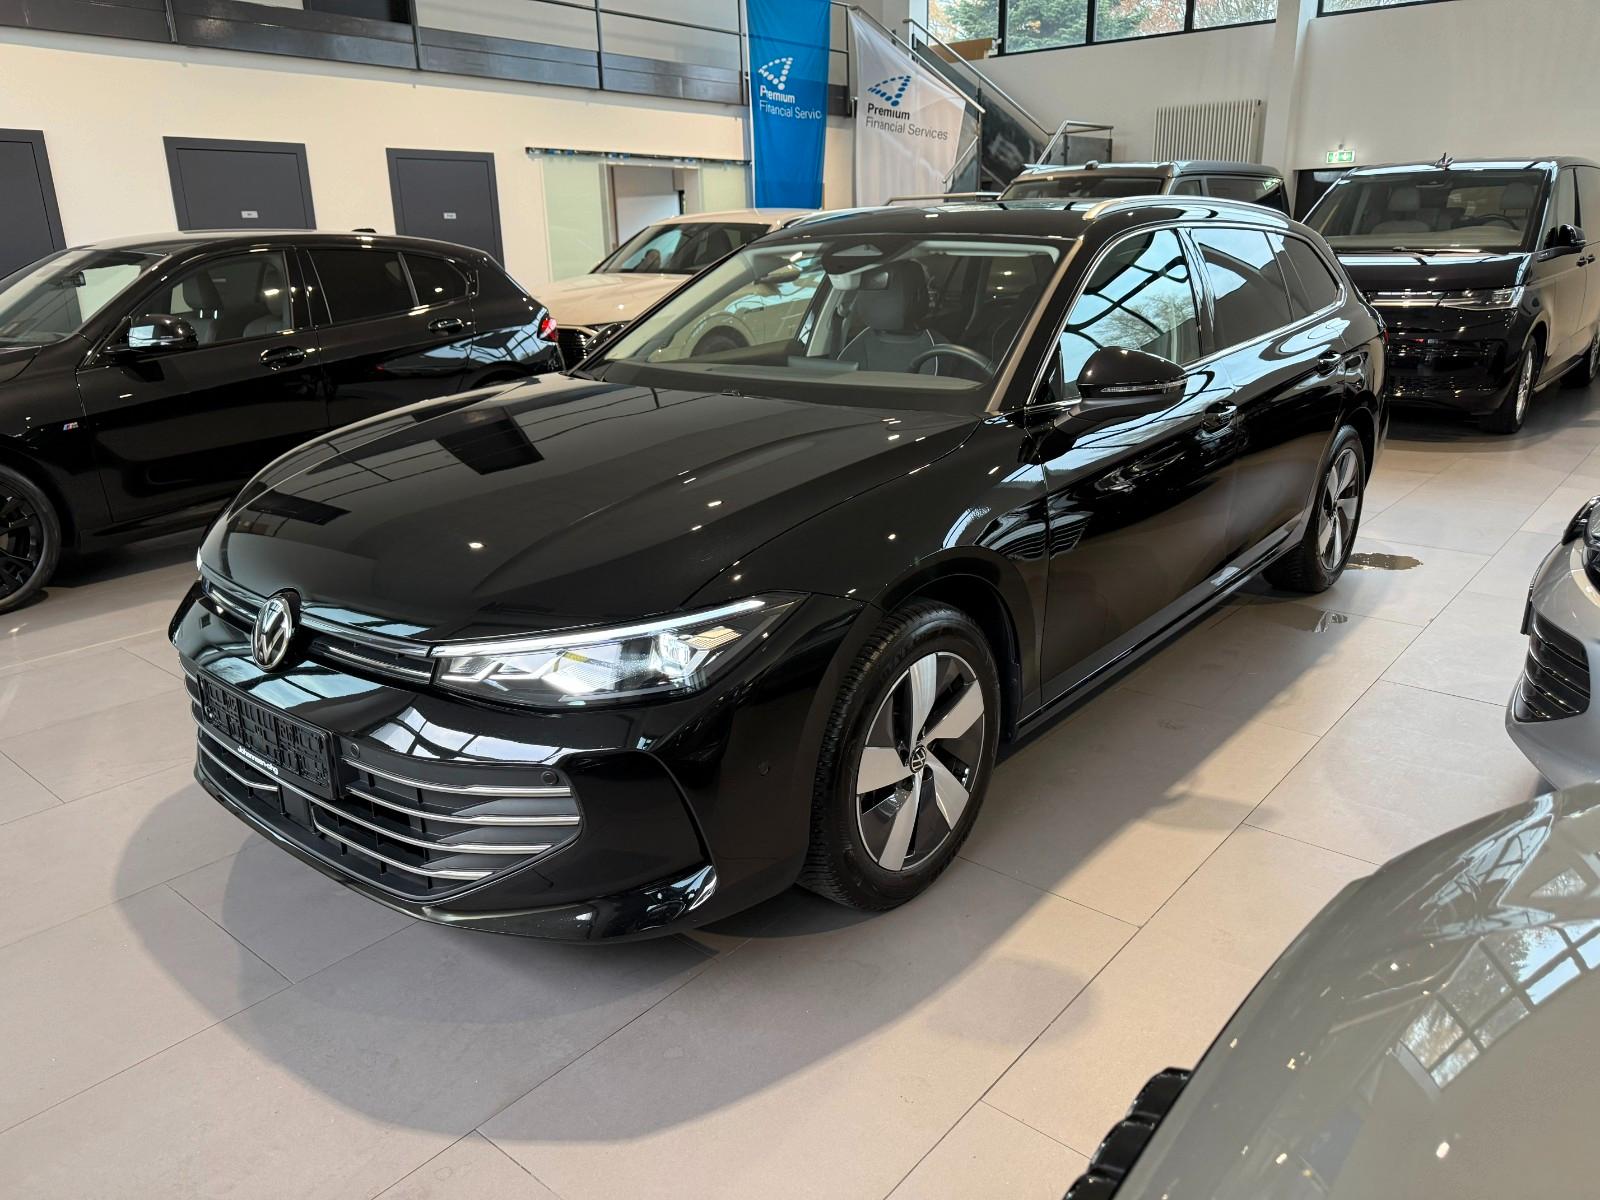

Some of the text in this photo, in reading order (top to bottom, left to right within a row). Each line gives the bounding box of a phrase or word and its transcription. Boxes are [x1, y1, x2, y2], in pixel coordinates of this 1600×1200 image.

[794, 106, 822, 120] Servic
[867, 102, 911, 120] Premium
[865, 116, 949, 141] Financial Services
